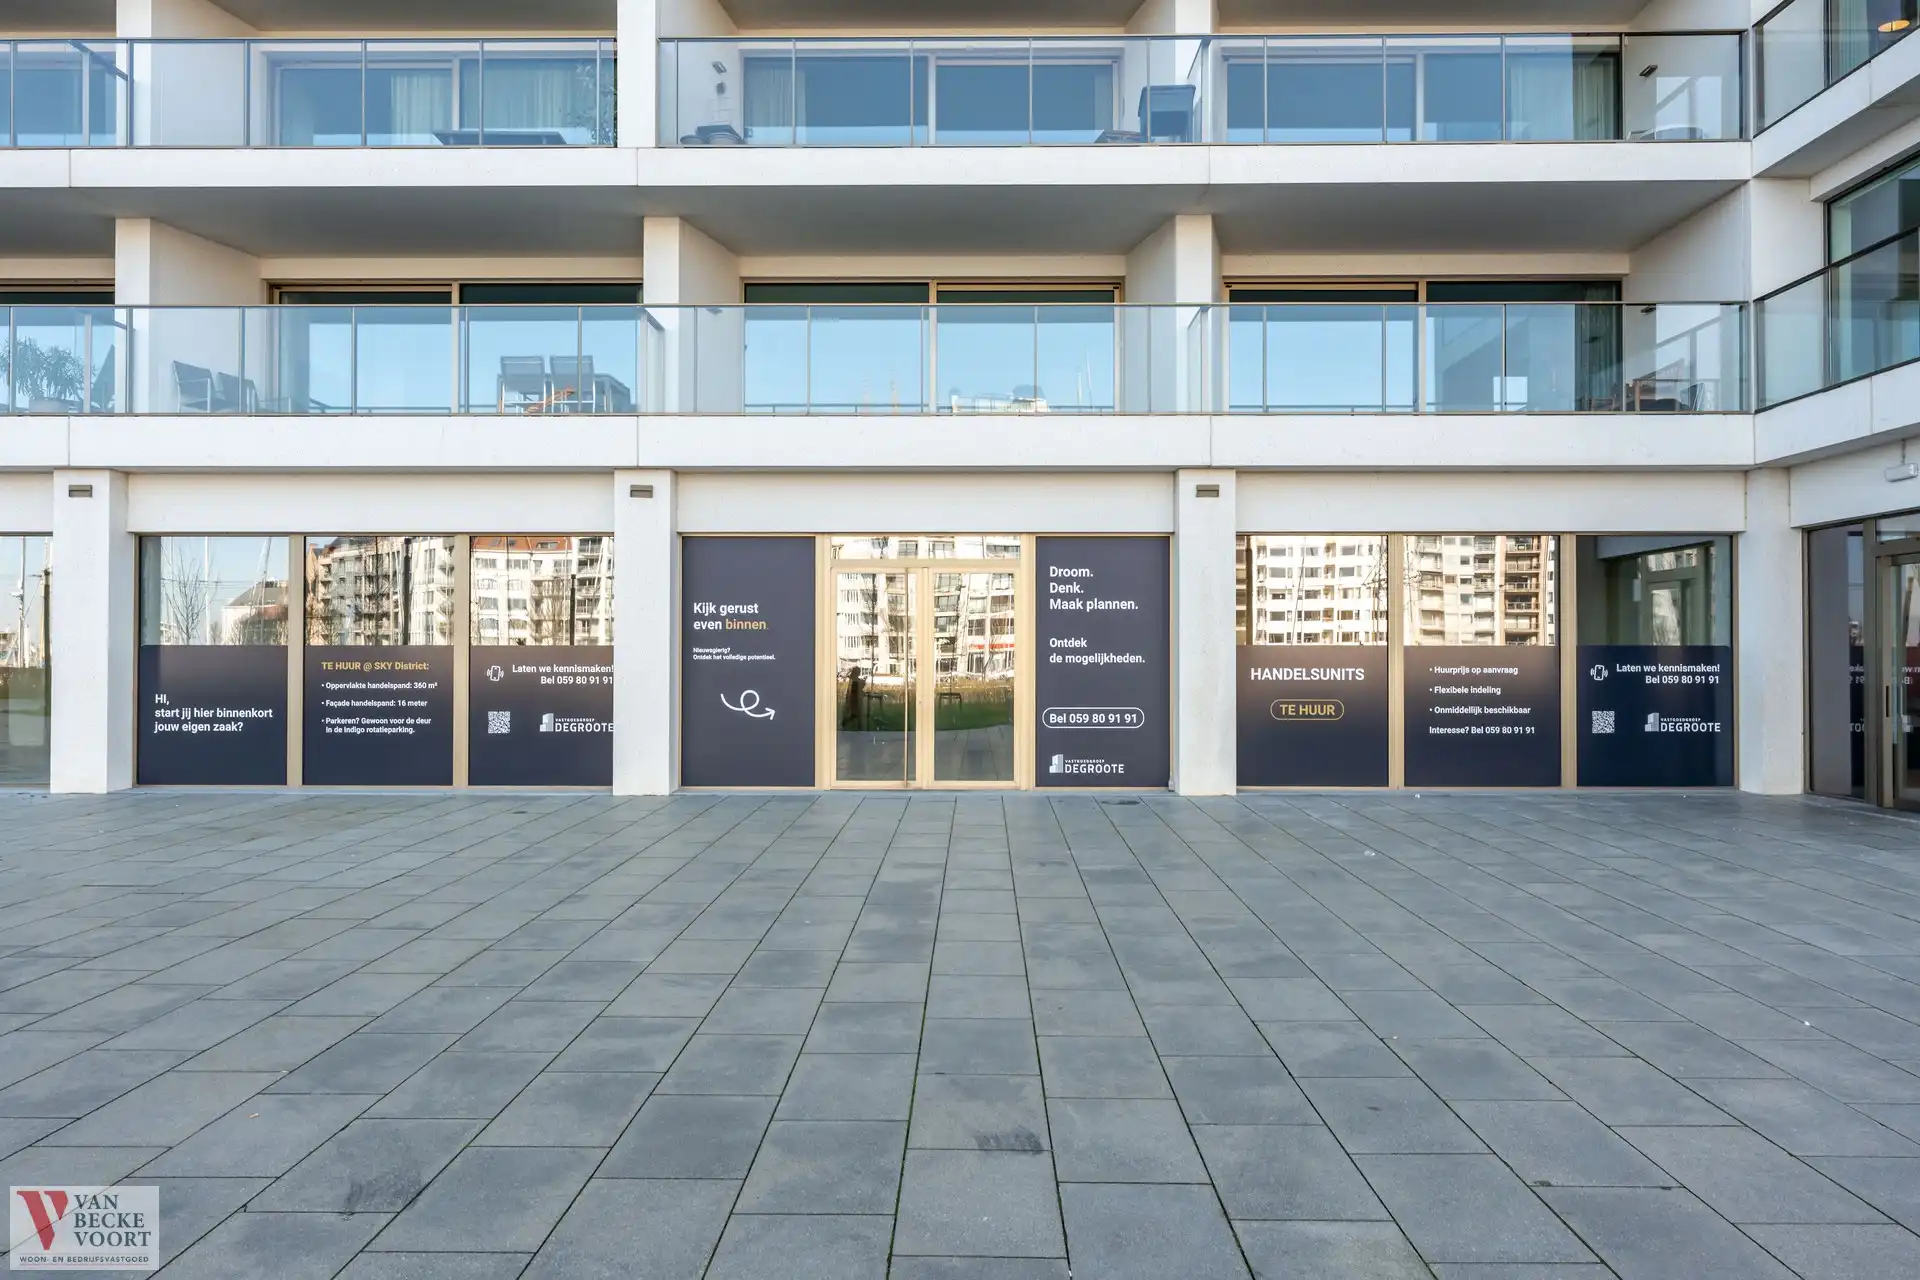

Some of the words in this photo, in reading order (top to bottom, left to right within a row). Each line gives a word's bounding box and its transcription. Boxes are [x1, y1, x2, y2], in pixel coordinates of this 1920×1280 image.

[1050, 566, 1094, 578] Droom.
[1050, 582, 1084, 594] Denk.
[694, 602, 716, 616] Kijk
[719, 603, 759, 616] gerust
[1050, 598, 1084, 610] Maak
[1086, 598, 1138, 612] plannen.
[693, 620, 722, 630] even
[1049, 637, 1088, 648] Ontdek
[1049, 652, 1063, 663] de
[1065, 652, 1146, 666] mogelijkheden.
[321, 662, 334, 670] TE
[335, 662, 361, 670] HUUR
[363, 662, 372, 672] @
[374, 661, 393, 670] SKY
[394, 661, 430, 670] District:
[512, 664, 537, 673] Laten
[1434, 665, 1470, 675] Huurprijs
[1471, 667, 1482, 675] op
[1482, 667, 1518, 676] aanvraag
[1616, 664, 1642, 672] Laten
[1658, 663, 1720, 672] kennismaken!
[1250, 668, 1365, 680] HANDELSUNITS
[1645, 674, 1660, 684] Bel
[1662, 675, 1679, 684] 059
[1681, 675, 1693, 684] 80
[1694, 675, 1705, 684] 91
[1708, 675, 1719, 684] 91
[540, 675, 555, 684] Bel
[556, 676, 574, 684] 059
[575, 676, 587, 684] 80
[589, 676, 600, 684] 91
[602, 676, 612, 684] 91
[325, 682, 366, 690] Oppervlakte
[367, 682, 412, 690] handelspand:
[1434, 686, 1469, 694] Flexibele
[1470, 686, 1501, 696] indeling
[326, 699, 350, 708] Façade
[351, 699, 396, 708] handelspand:
[154, 708, 180, 718] start
[180, 708, 191, 720] jij
[194, 707, 214, 718] hier
[216, 707, 273, 718] binnenkort
[1279, 704, 1296, 716] TE
[1299, 704, 1335, 716] HUUR
[1434, 706, 1483, 716] Onmiddellijk
[1484, 706, 1531, 714] beschikbaar
[1050, 713, 1066, 724] Bel
[1069, 713, 1089, 724] 059
[1092, 713, 1106, 724] 80
[1108, 713, 1120, 724] 91
[1124, 713, 1136, 724] 91
[154, 721, 180, 734] jouw
[182, 720, 210, 734] eigen
[213, 721, 244, 732] zaak?
[344, 726, 365, 735] Indigo
[366, 726, 415, 734] rotatieparking.
[1429, 726, 1470, 734] Interesse?
[1471, 726, 1484, 734] Bel
[1502, 726, 1512, 734] 80
[1513, 726, 1523, 734] 91
[1660, 722, 1721, 732] DEGROOTE
[1064, 764, 1124, 774] DEGROOTE
